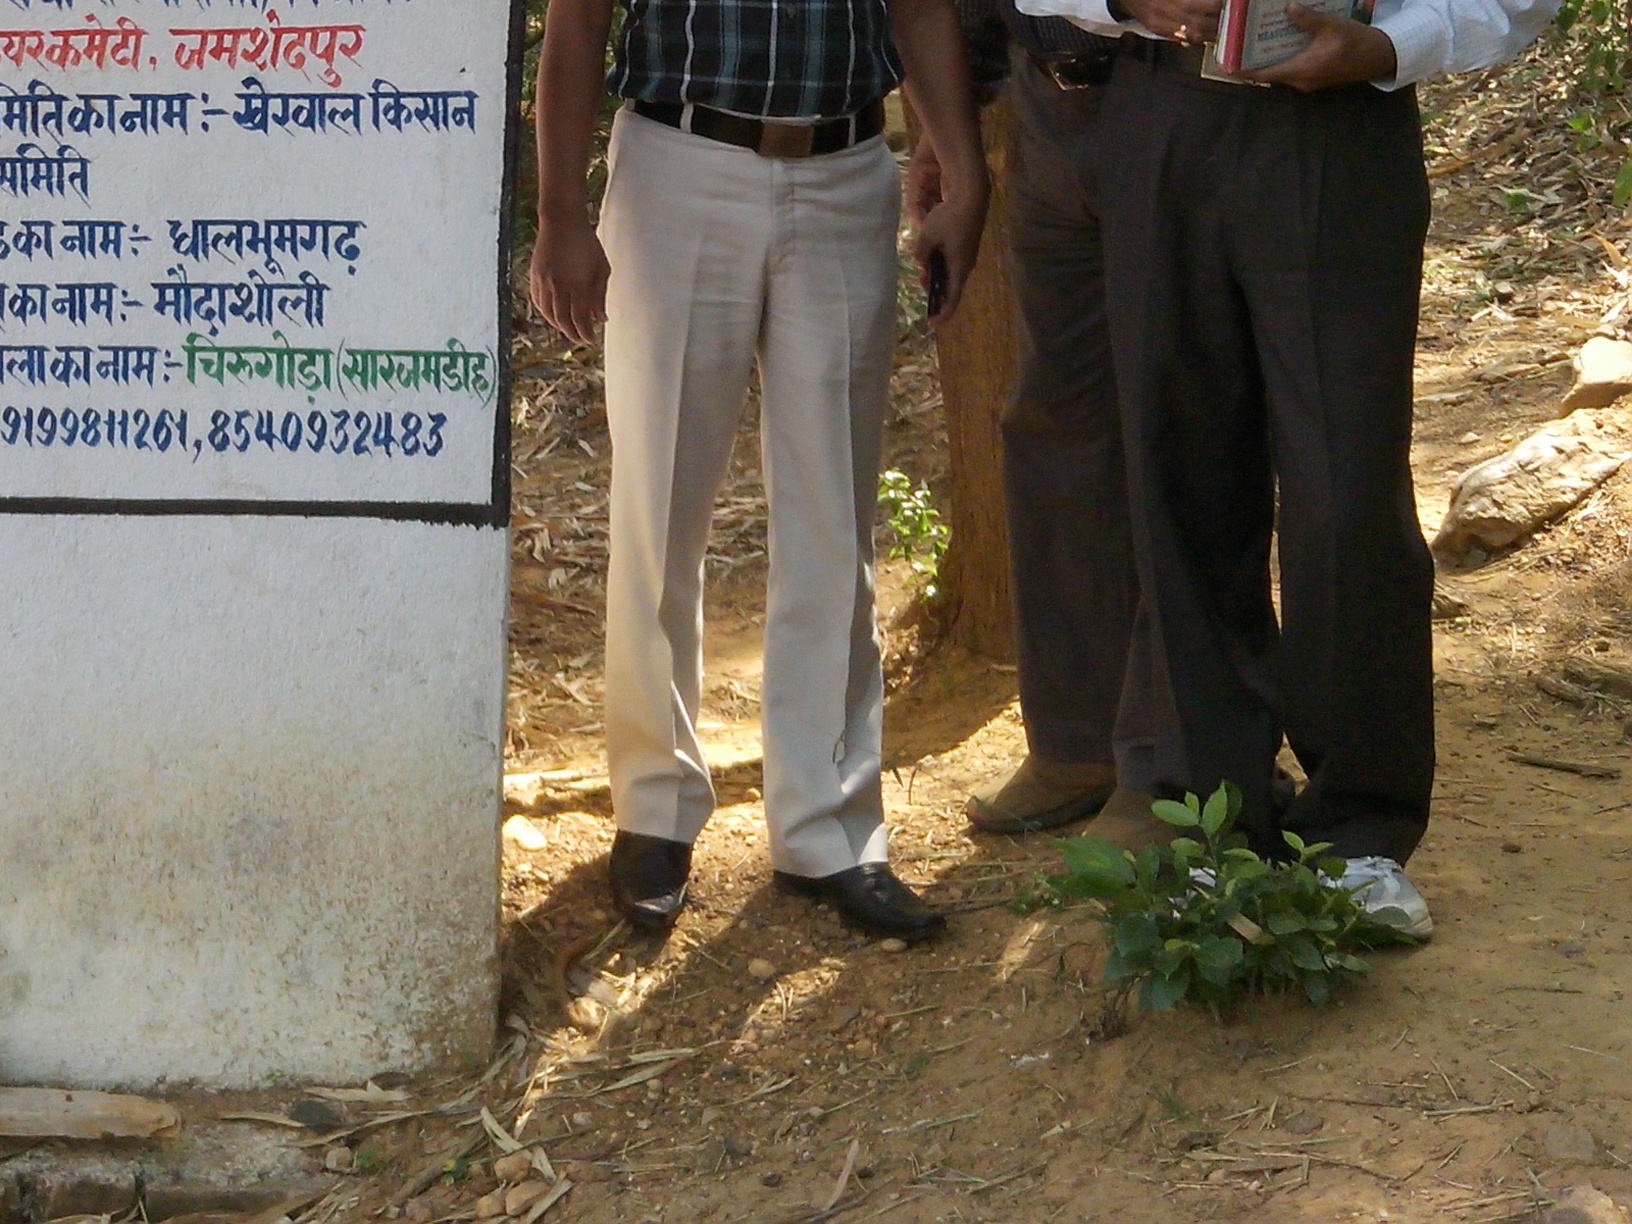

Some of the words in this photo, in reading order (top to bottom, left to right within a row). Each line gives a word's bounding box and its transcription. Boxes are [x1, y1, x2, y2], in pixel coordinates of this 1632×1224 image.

[168, 8, 367, 88] जमशेदपुर
[67, 93, 122, 135] का
[367, 78, 481, 134] किसान
[12, 220, 57, 261] का
[9, 283, 50, 325] का
[50, 346, 93, 388] का
